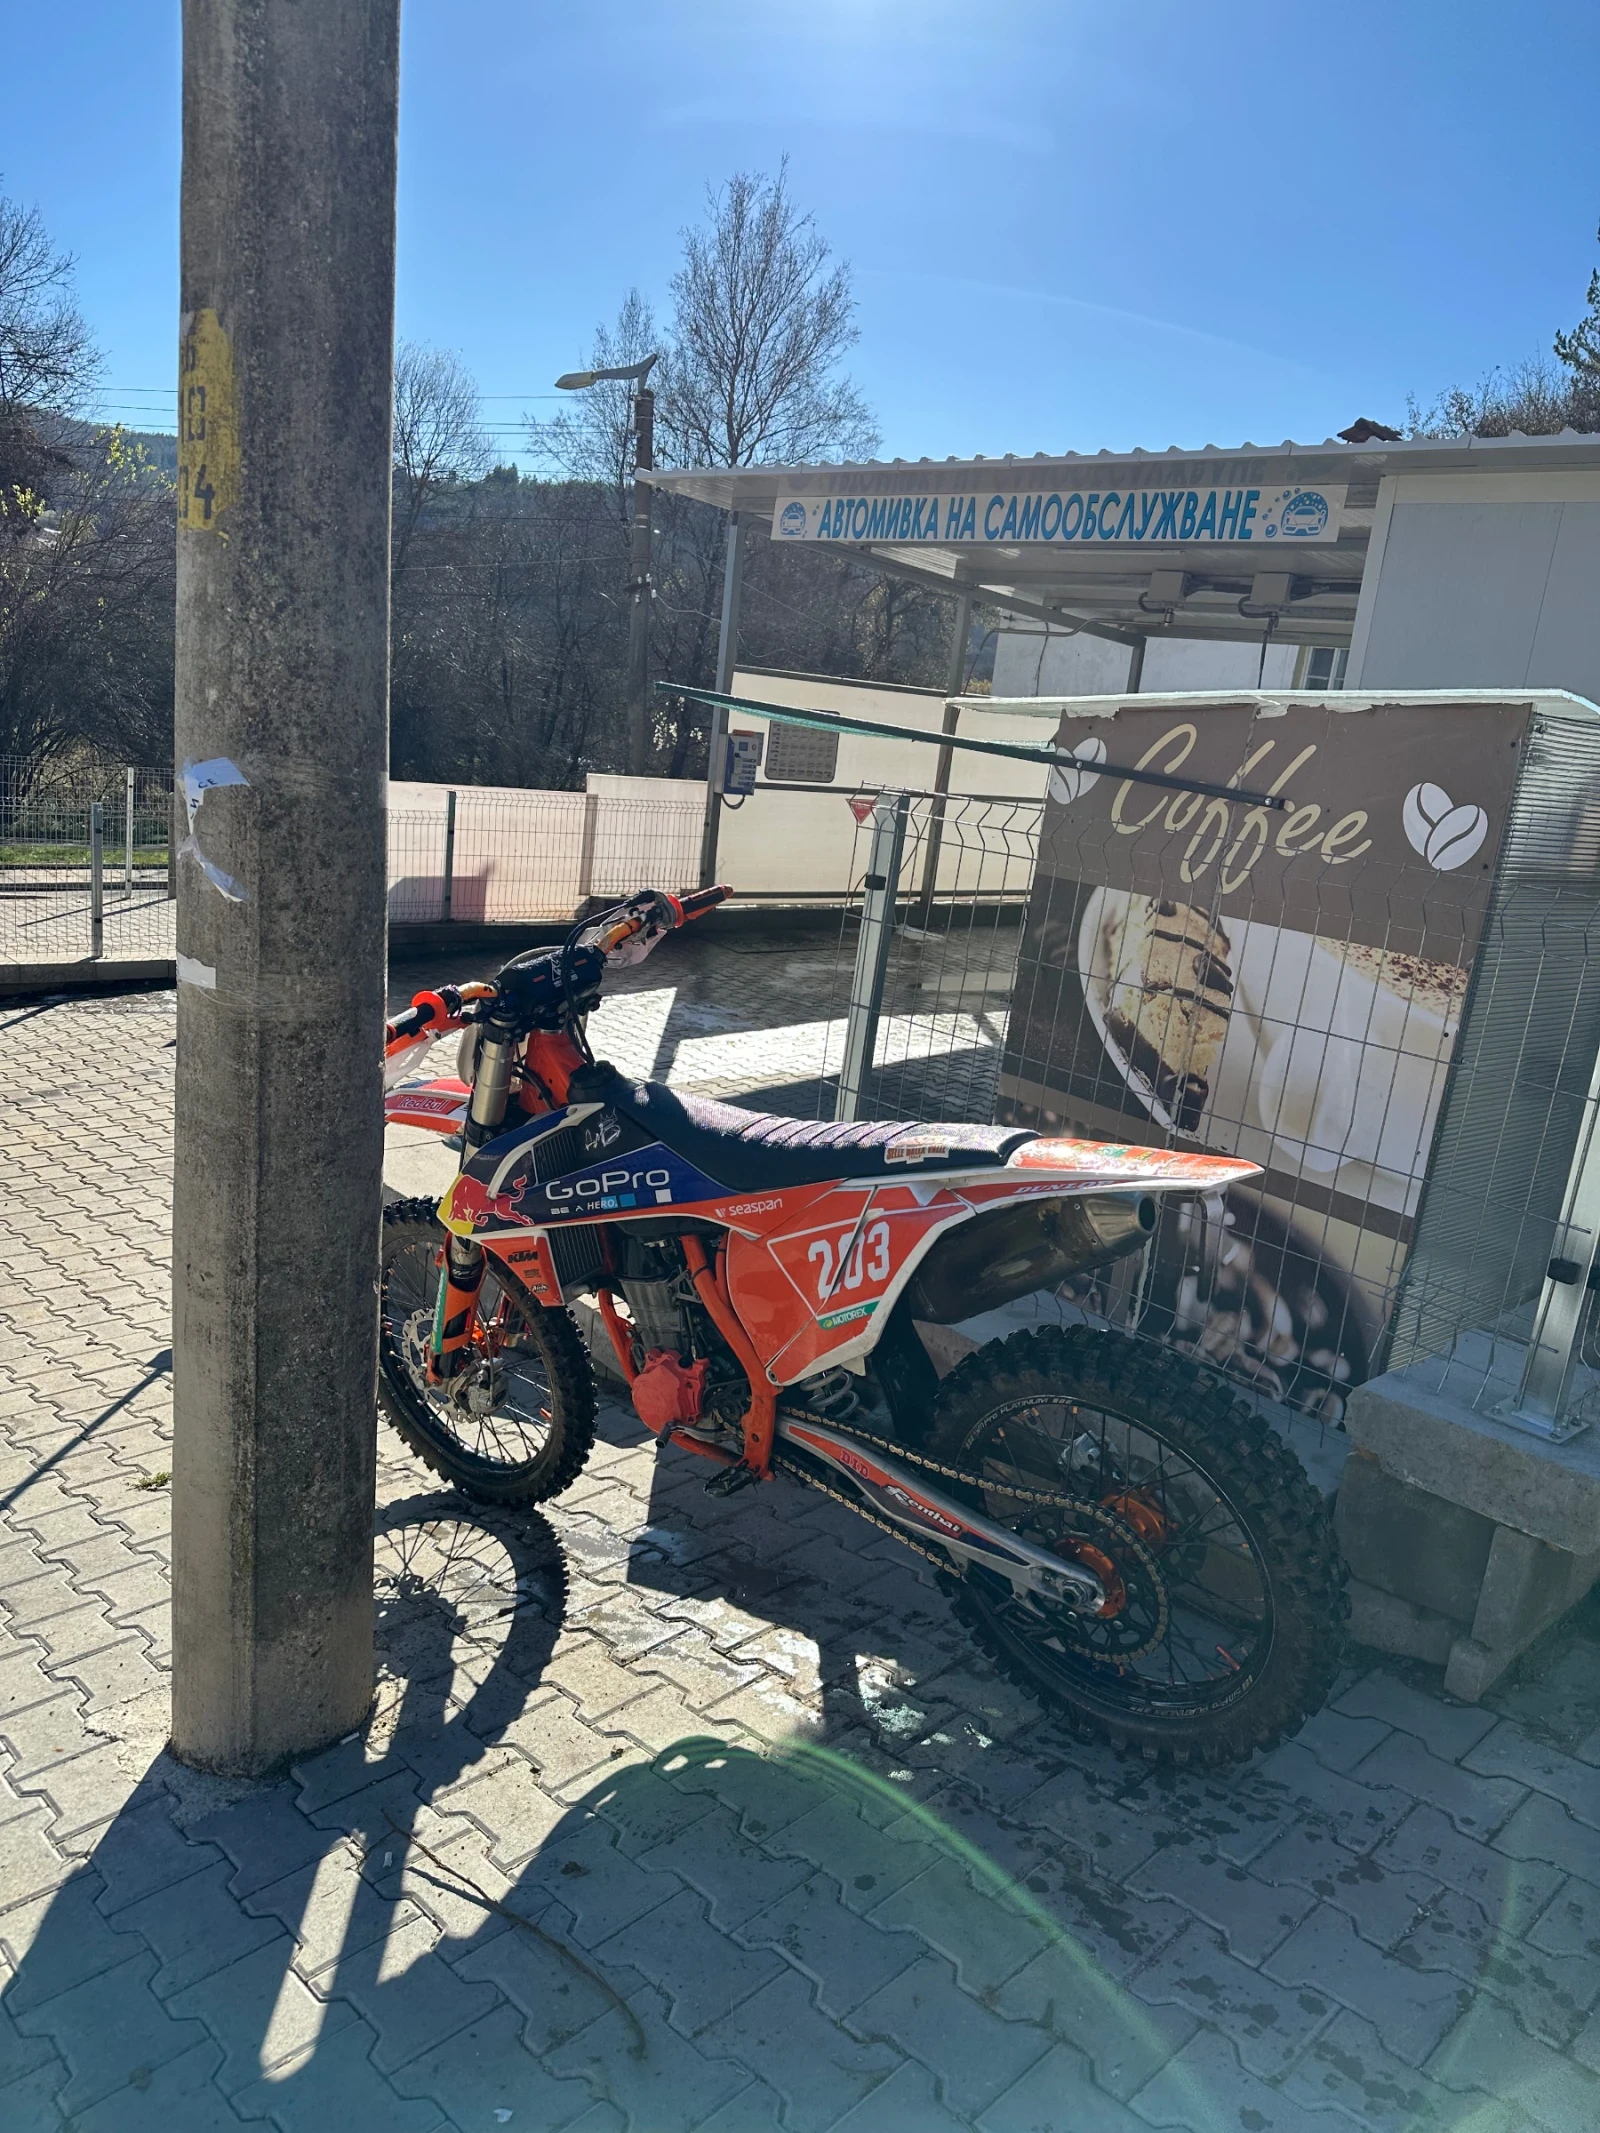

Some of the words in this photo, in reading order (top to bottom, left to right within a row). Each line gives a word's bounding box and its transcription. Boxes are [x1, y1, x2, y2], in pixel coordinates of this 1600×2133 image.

[817, 497, 939, 540] АВТОМИВКА
[945, 496, 976, 540] НА
[984, 489, 1260, 541] САМООБСЛУЖВАНЕ
[1111, 723, 1372, 895] Coffee
[398, 1096, 422, 1109] Red
[421, 1098, 450, 1112] Bull
[545, 1169, 670, 1201] GoPro
[1012, 1180, 1115, 1194] DUNLOP
[550, 1206, 570, 1215] BE
[728, 1197, 783, 1216] seaspan
[507, 1250, 539, 1264] KTM
[807, 1221, 890, 1300] 203
[831, 1306, 868, 1326] MOTOREX
[883, 1485, 960, 1532] Renthal
